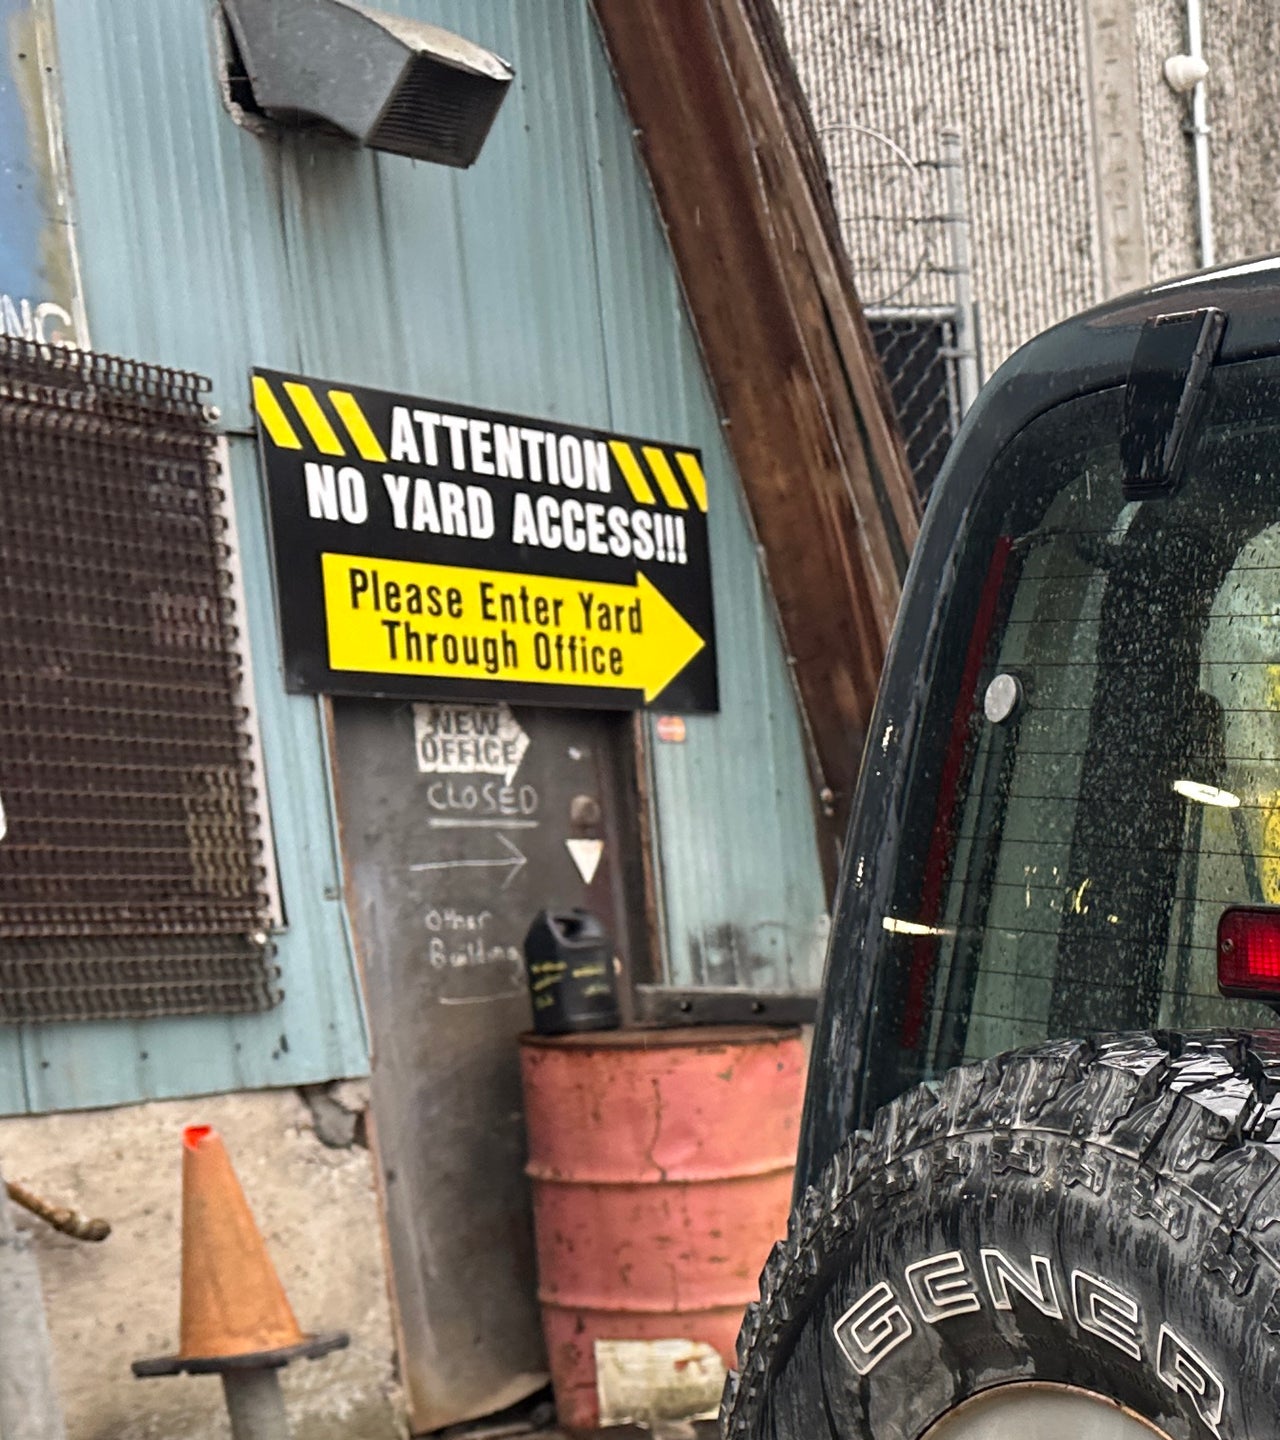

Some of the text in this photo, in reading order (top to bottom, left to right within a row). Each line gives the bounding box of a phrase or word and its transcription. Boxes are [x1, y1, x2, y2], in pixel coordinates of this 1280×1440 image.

[389, 405, 612, 494] ATTENTION
[303, 462, 688, 565] NO YARD ACCESS!!!
[348, 568, 643, 634] Please Enter Yard
[381, 619, 625, 676] Through Office
[428, 705, 499, 735] NEW
[421, 735, 518, 765] OFFICE
[426, 780, 539, 815] CLOSED
